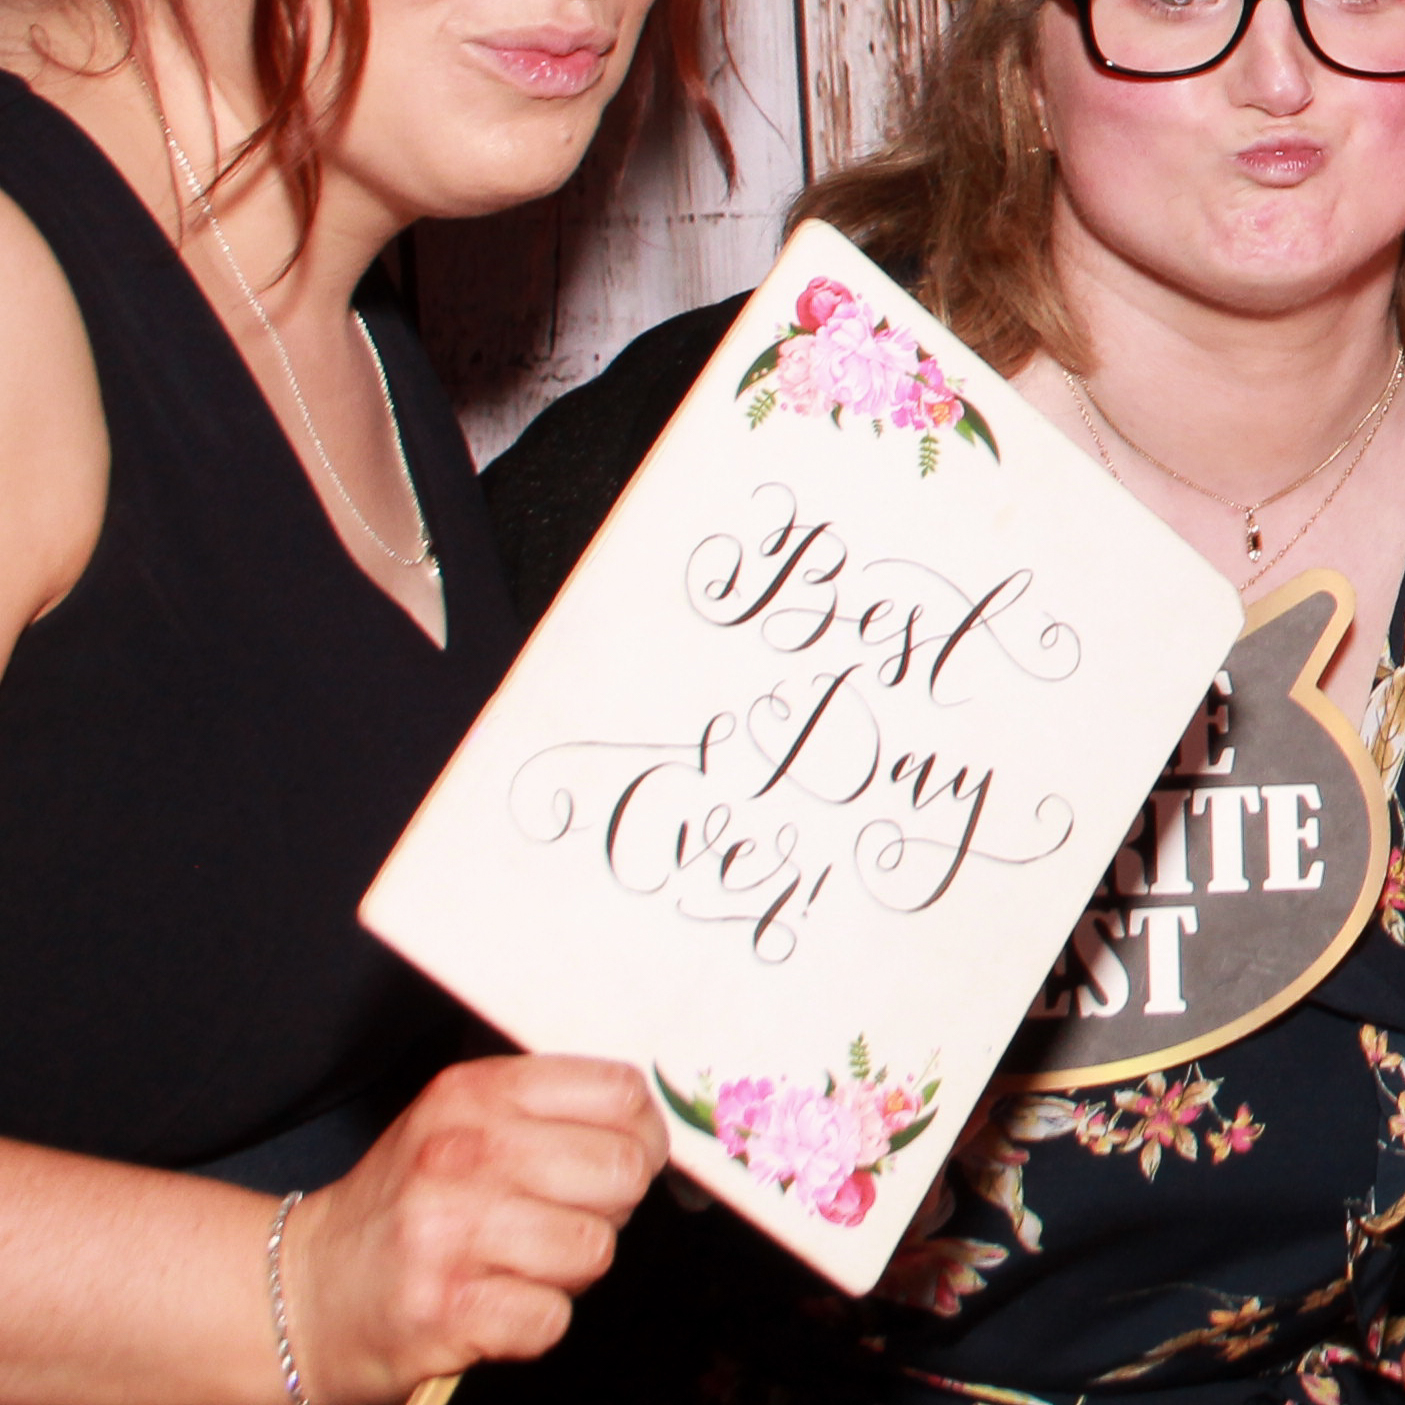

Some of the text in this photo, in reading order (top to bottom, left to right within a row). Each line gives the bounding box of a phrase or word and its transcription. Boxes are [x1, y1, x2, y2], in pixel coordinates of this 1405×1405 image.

[685, 482, 1081, 707] Best
[508, 711, 833, 965] Ever!
[747, 663, 1074, 913] Day
